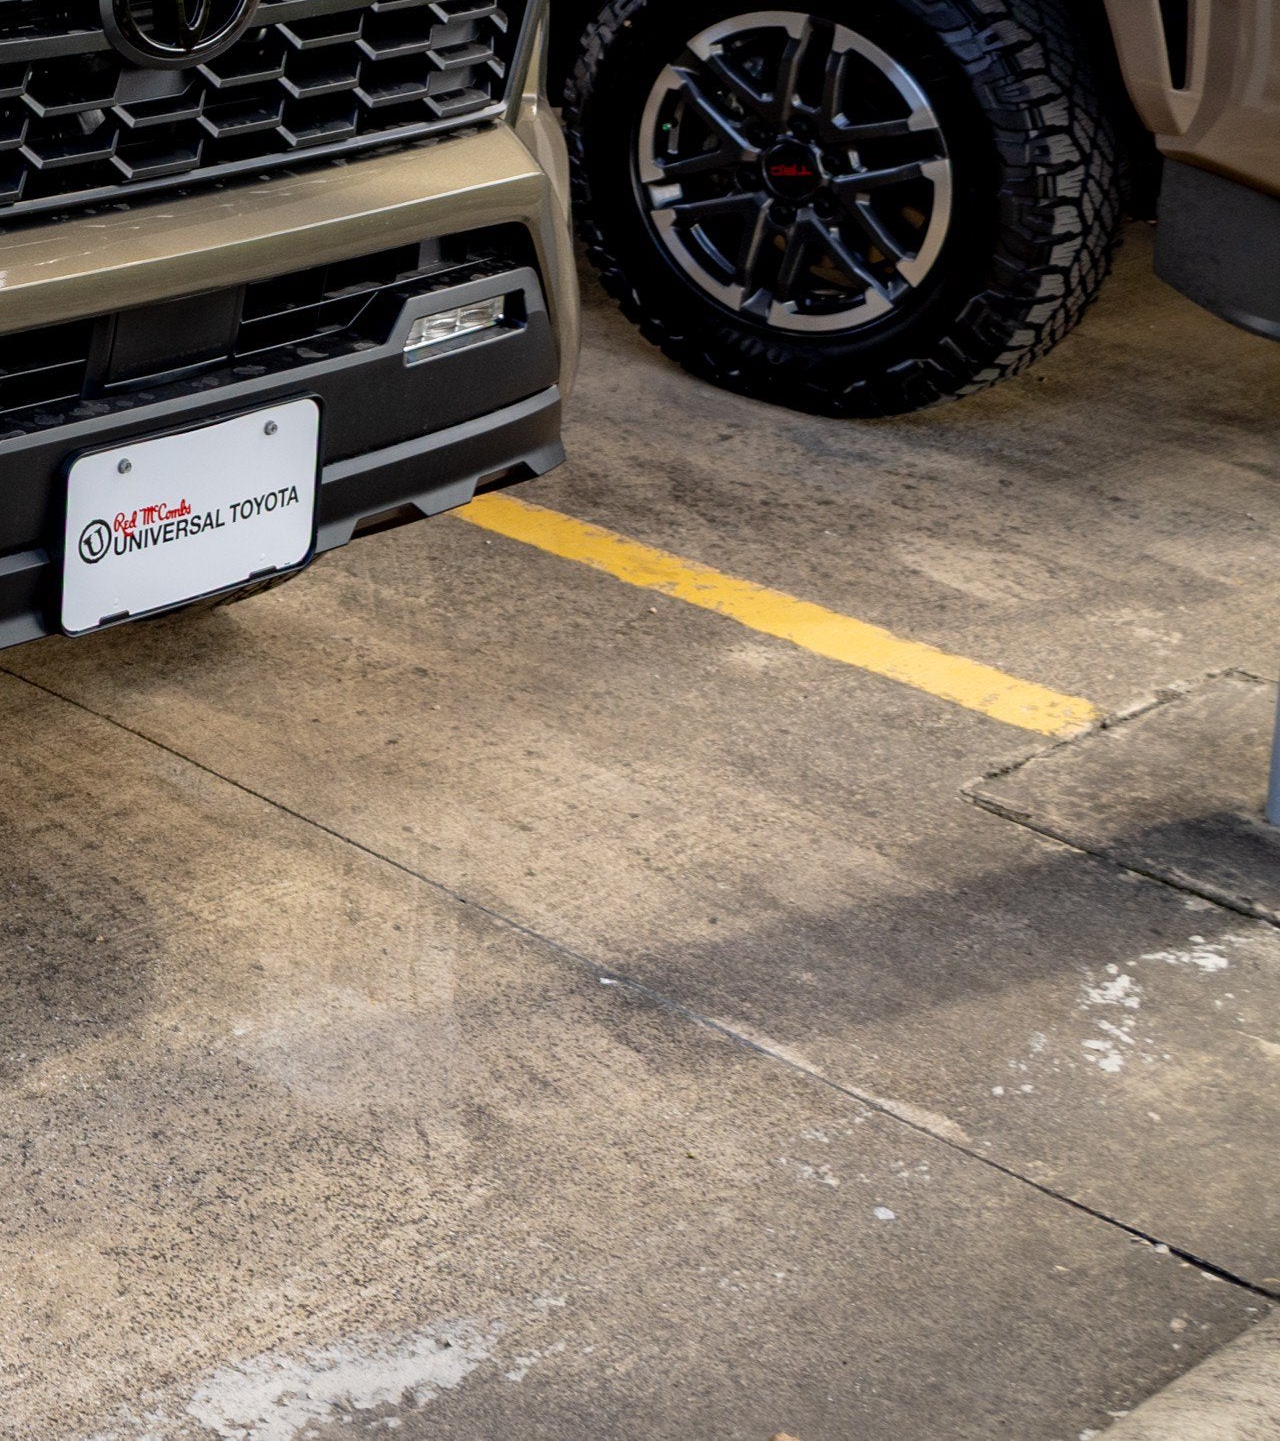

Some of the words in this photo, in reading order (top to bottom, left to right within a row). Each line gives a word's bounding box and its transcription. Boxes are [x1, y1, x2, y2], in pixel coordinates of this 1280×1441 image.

[113, 511, 138, 536] Red
[140, 498, 191, 526] McCombs
[113, 508, 225, 556] UNIVERSAL
[230, 486, 299, 523] TOYOTA
